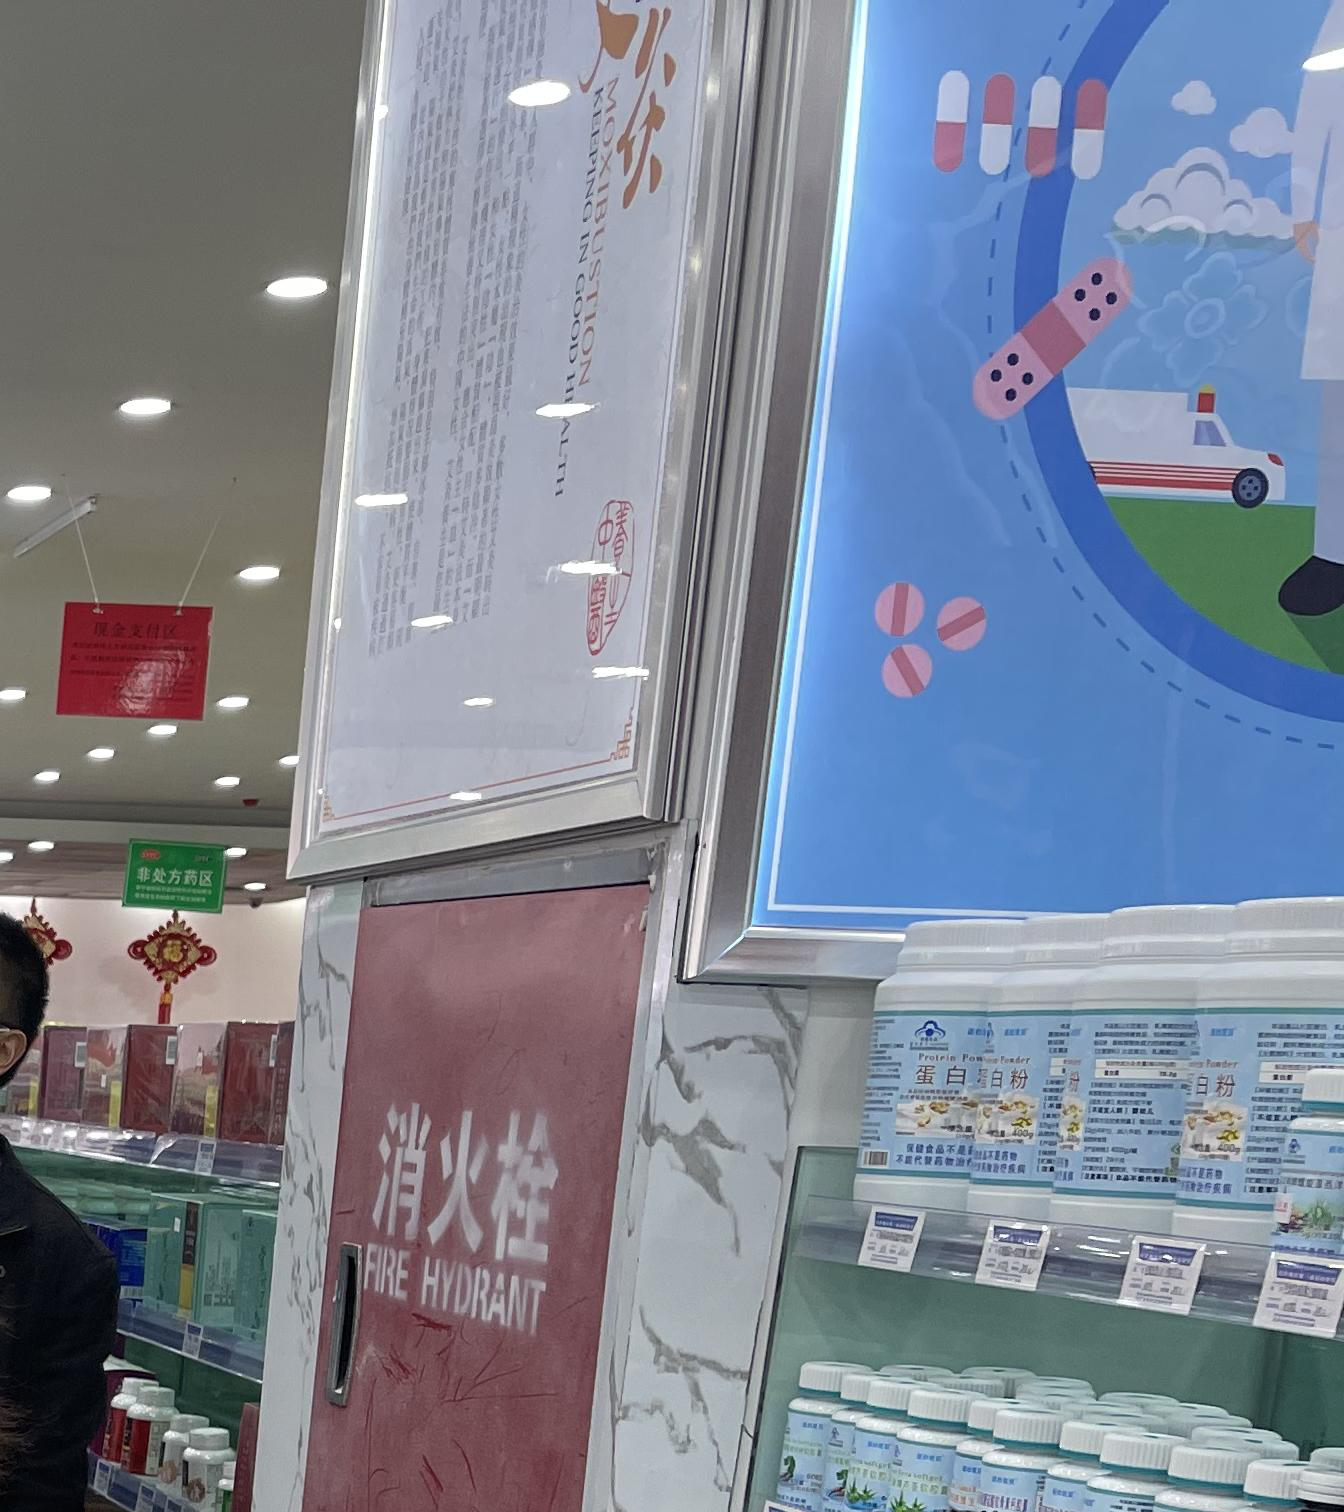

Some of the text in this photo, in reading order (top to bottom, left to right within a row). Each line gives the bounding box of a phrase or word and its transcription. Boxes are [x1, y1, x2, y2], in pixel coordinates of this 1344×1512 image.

[555, 87, 604, 497] KEEPING IN GOOD HALTH
[578, 75, 619, 386] MOXIBUSTION
[136, 866, 215, 885] 非处方药区
[962, 1053, 984, 1063] Pow
[372, 1102, 560, 1263] 消火栓
[363, 1243, 547, 1336] FIRE HYDRANT
